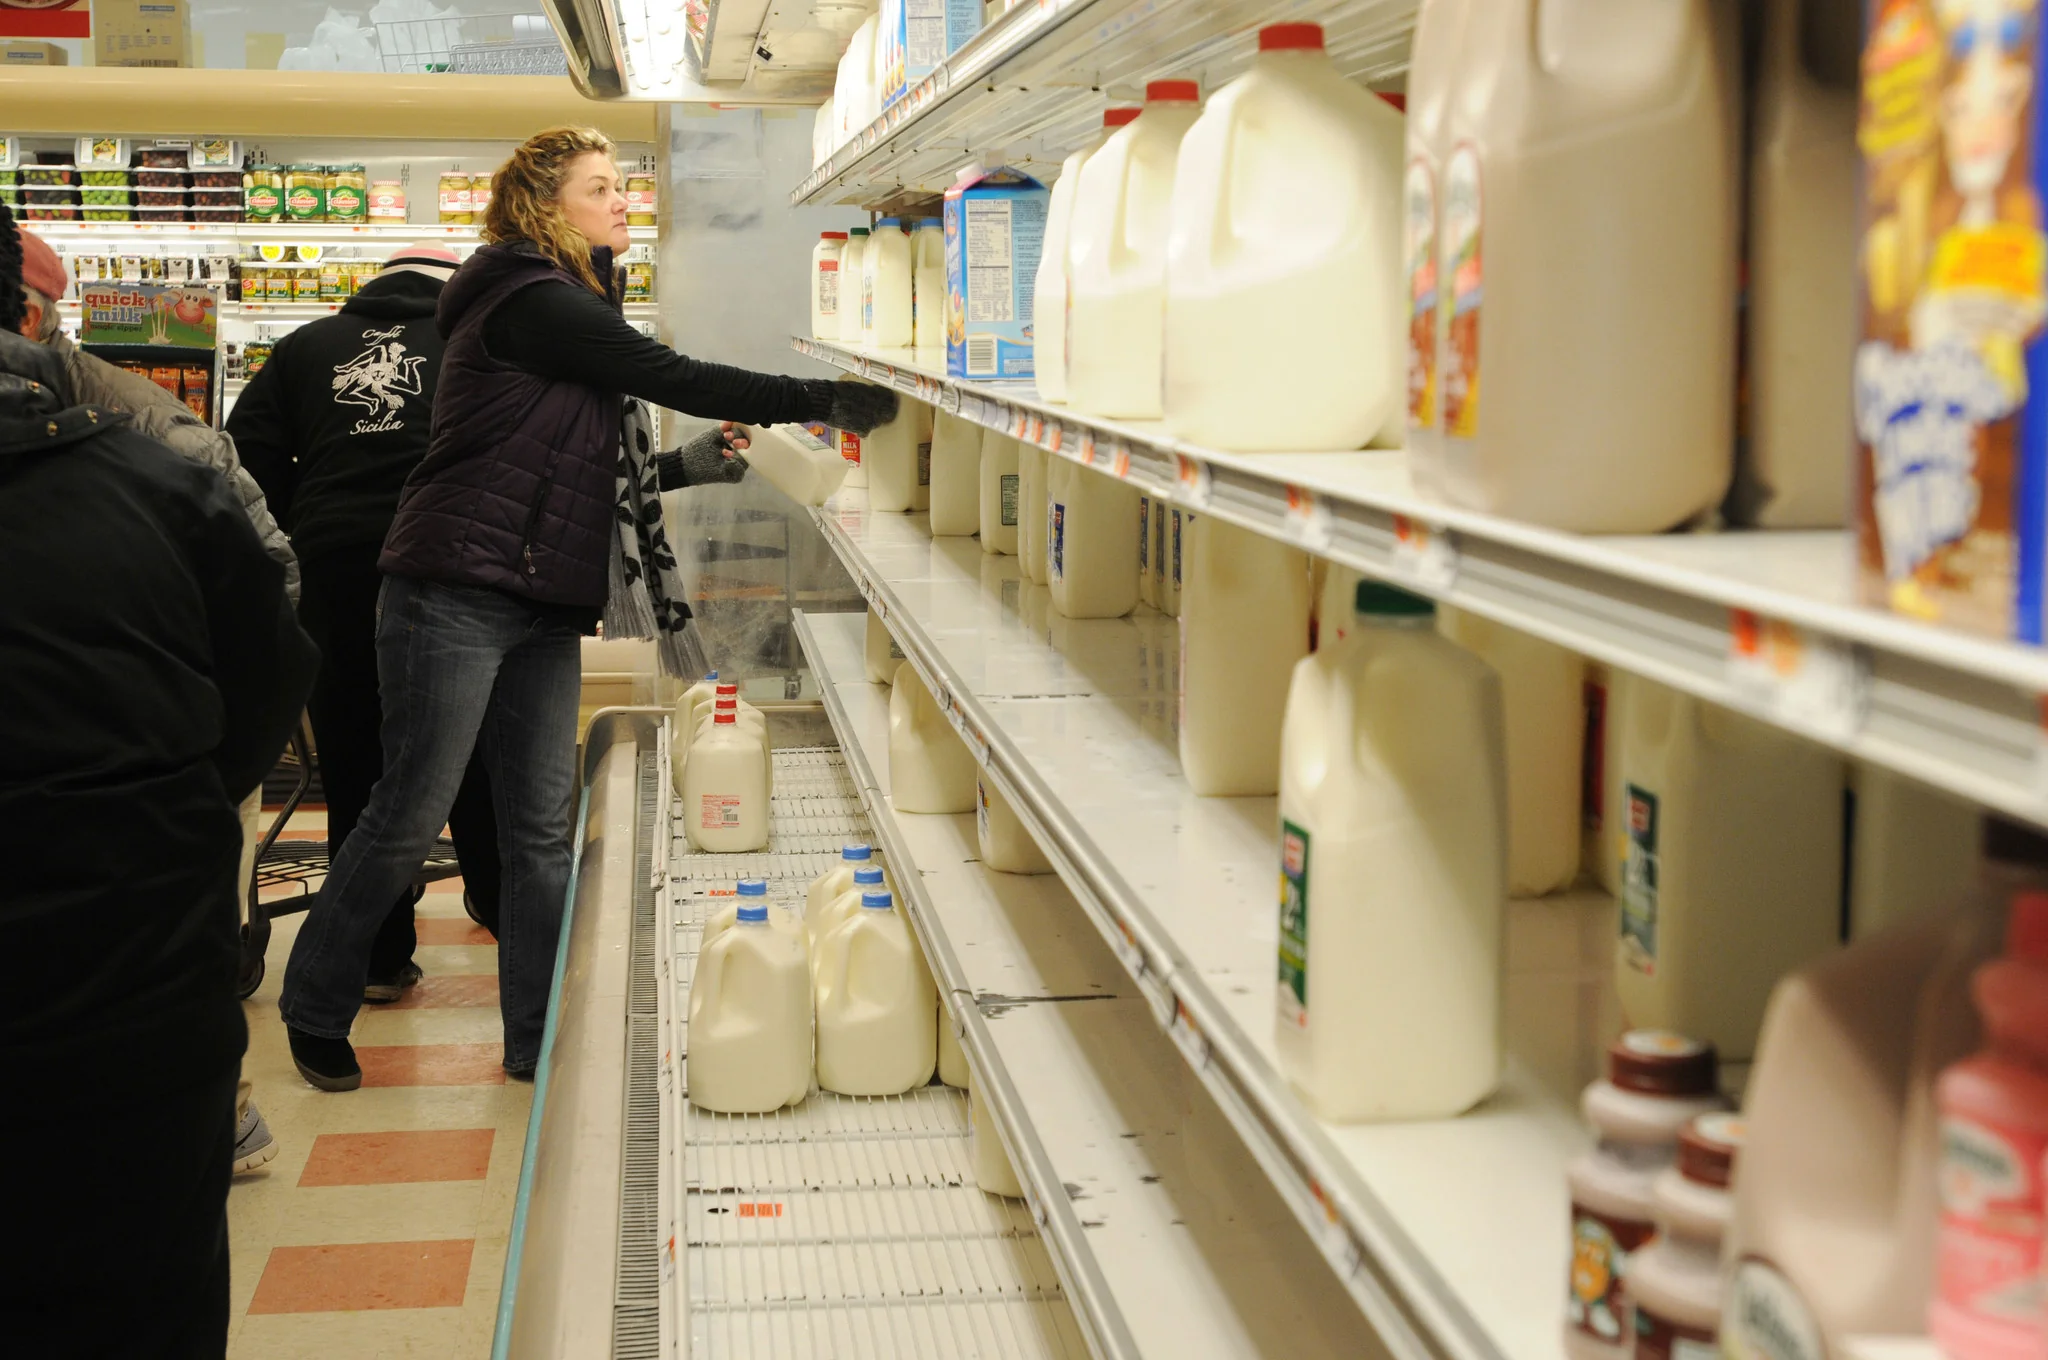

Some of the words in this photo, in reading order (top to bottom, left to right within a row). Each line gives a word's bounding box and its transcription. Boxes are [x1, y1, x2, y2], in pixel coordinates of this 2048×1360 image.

[85, 291, 146, 308] quick
[91, 306, 142, 323] milk
[349, 409, 405, 435] Sicilia
